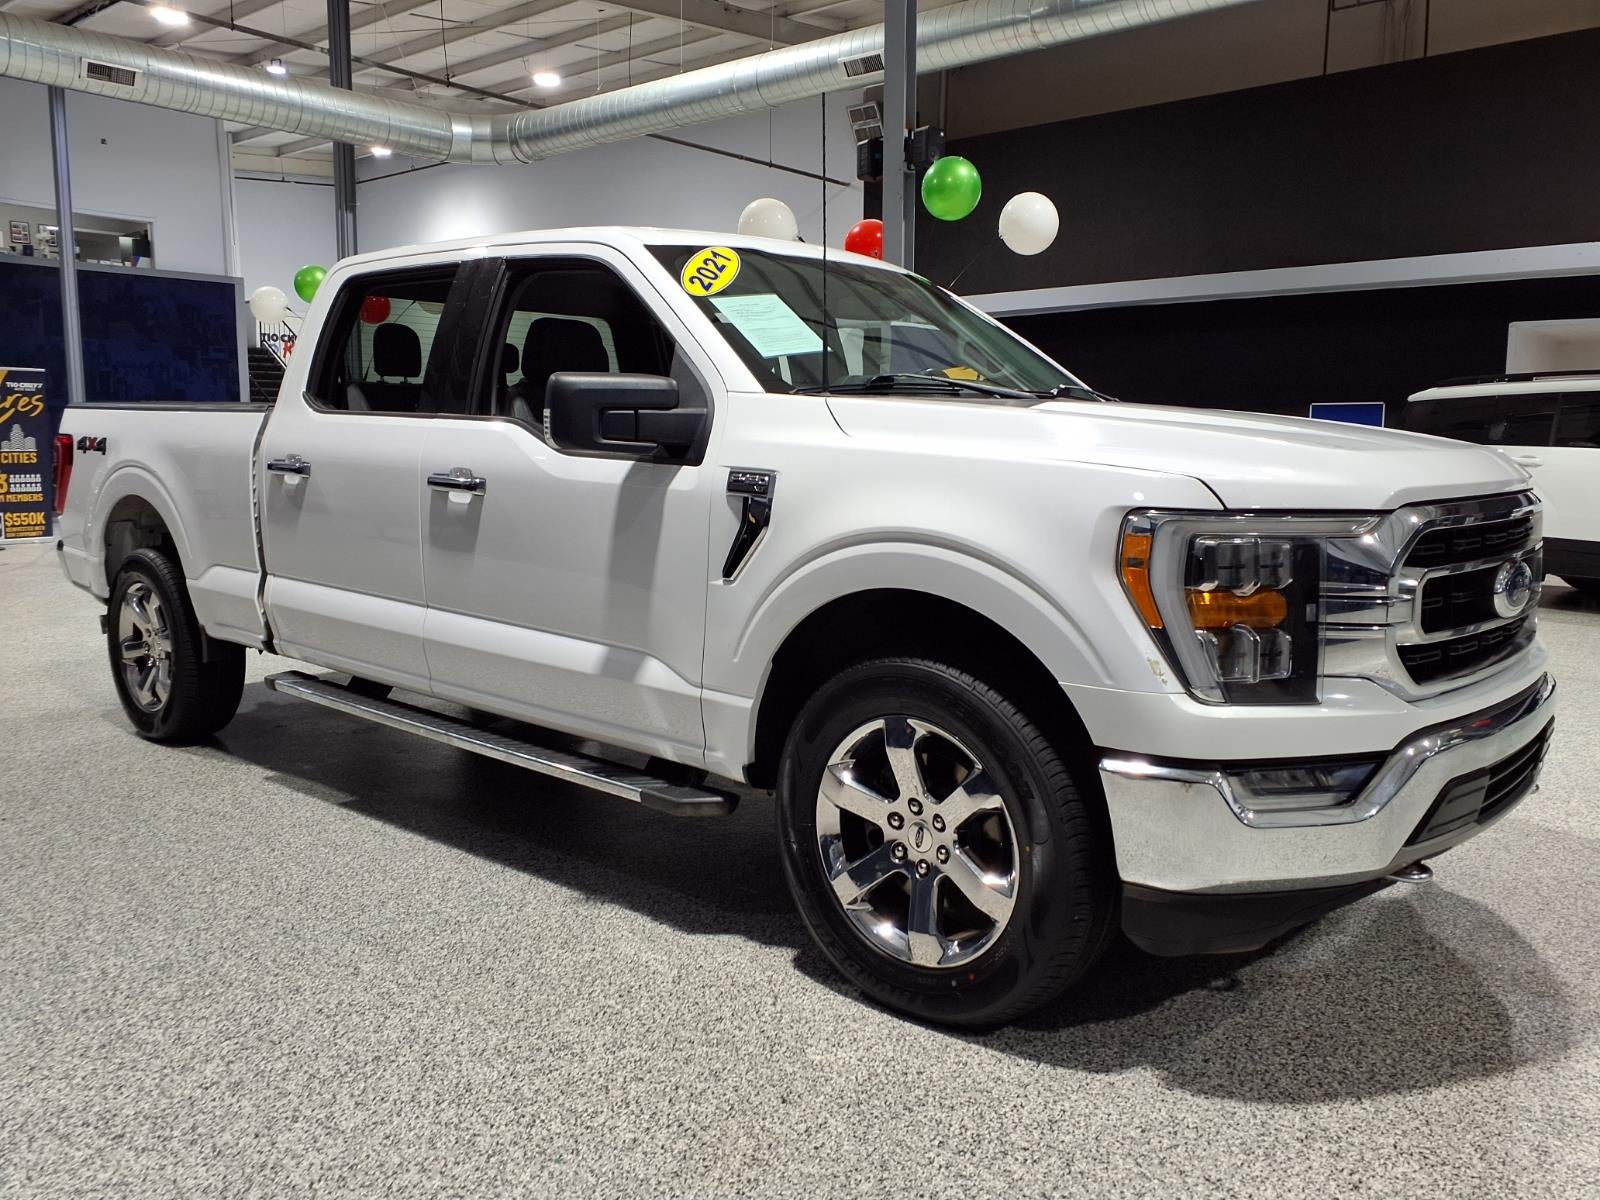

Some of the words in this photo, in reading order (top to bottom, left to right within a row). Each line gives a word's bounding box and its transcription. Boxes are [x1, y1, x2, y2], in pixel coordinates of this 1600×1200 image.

[688, 250, 732, 292] 2021
[1, 452, 38, 464] CITIES
[6, 493, 44, 502] MEMBERS
[4, 512, 46, 526] $550K
